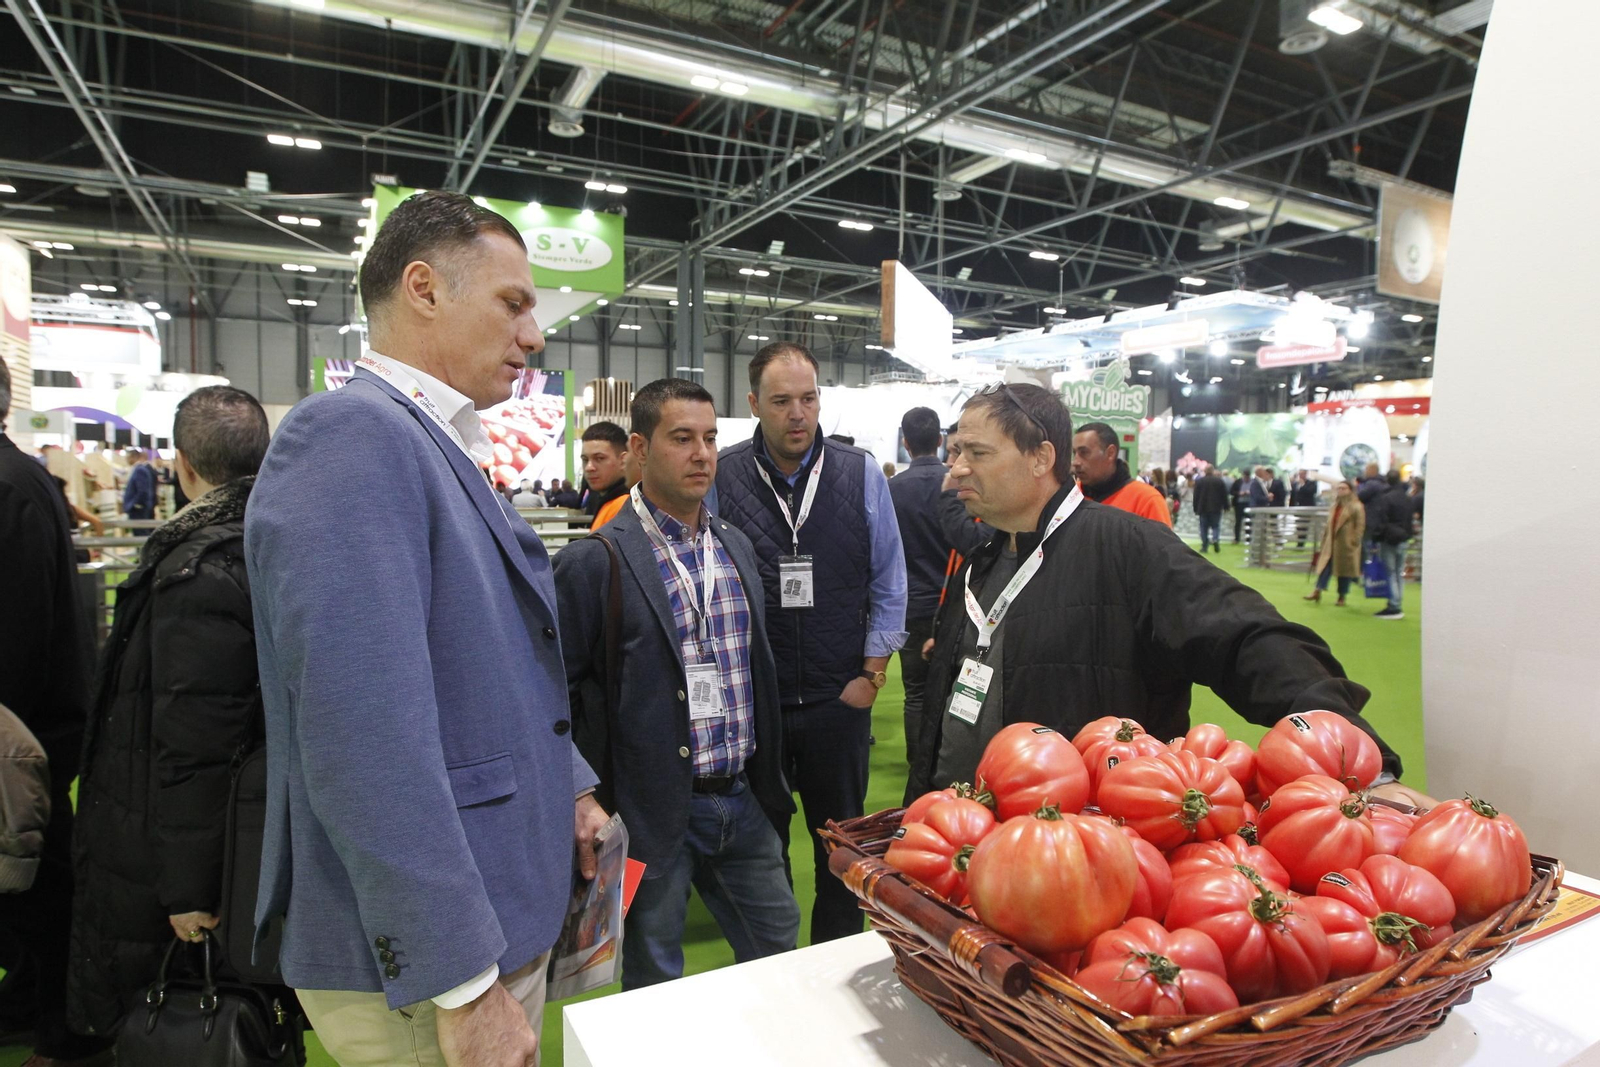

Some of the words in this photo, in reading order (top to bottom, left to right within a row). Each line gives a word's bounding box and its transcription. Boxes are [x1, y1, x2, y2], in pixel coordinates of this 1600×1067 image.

[537, 234, 551, 251] S
[571, 236, 590, 255] V
[375, 362, 392, 376] Agro
[423, 396, 436, 409] fruit
[419, 400, 446, 427] attraction
